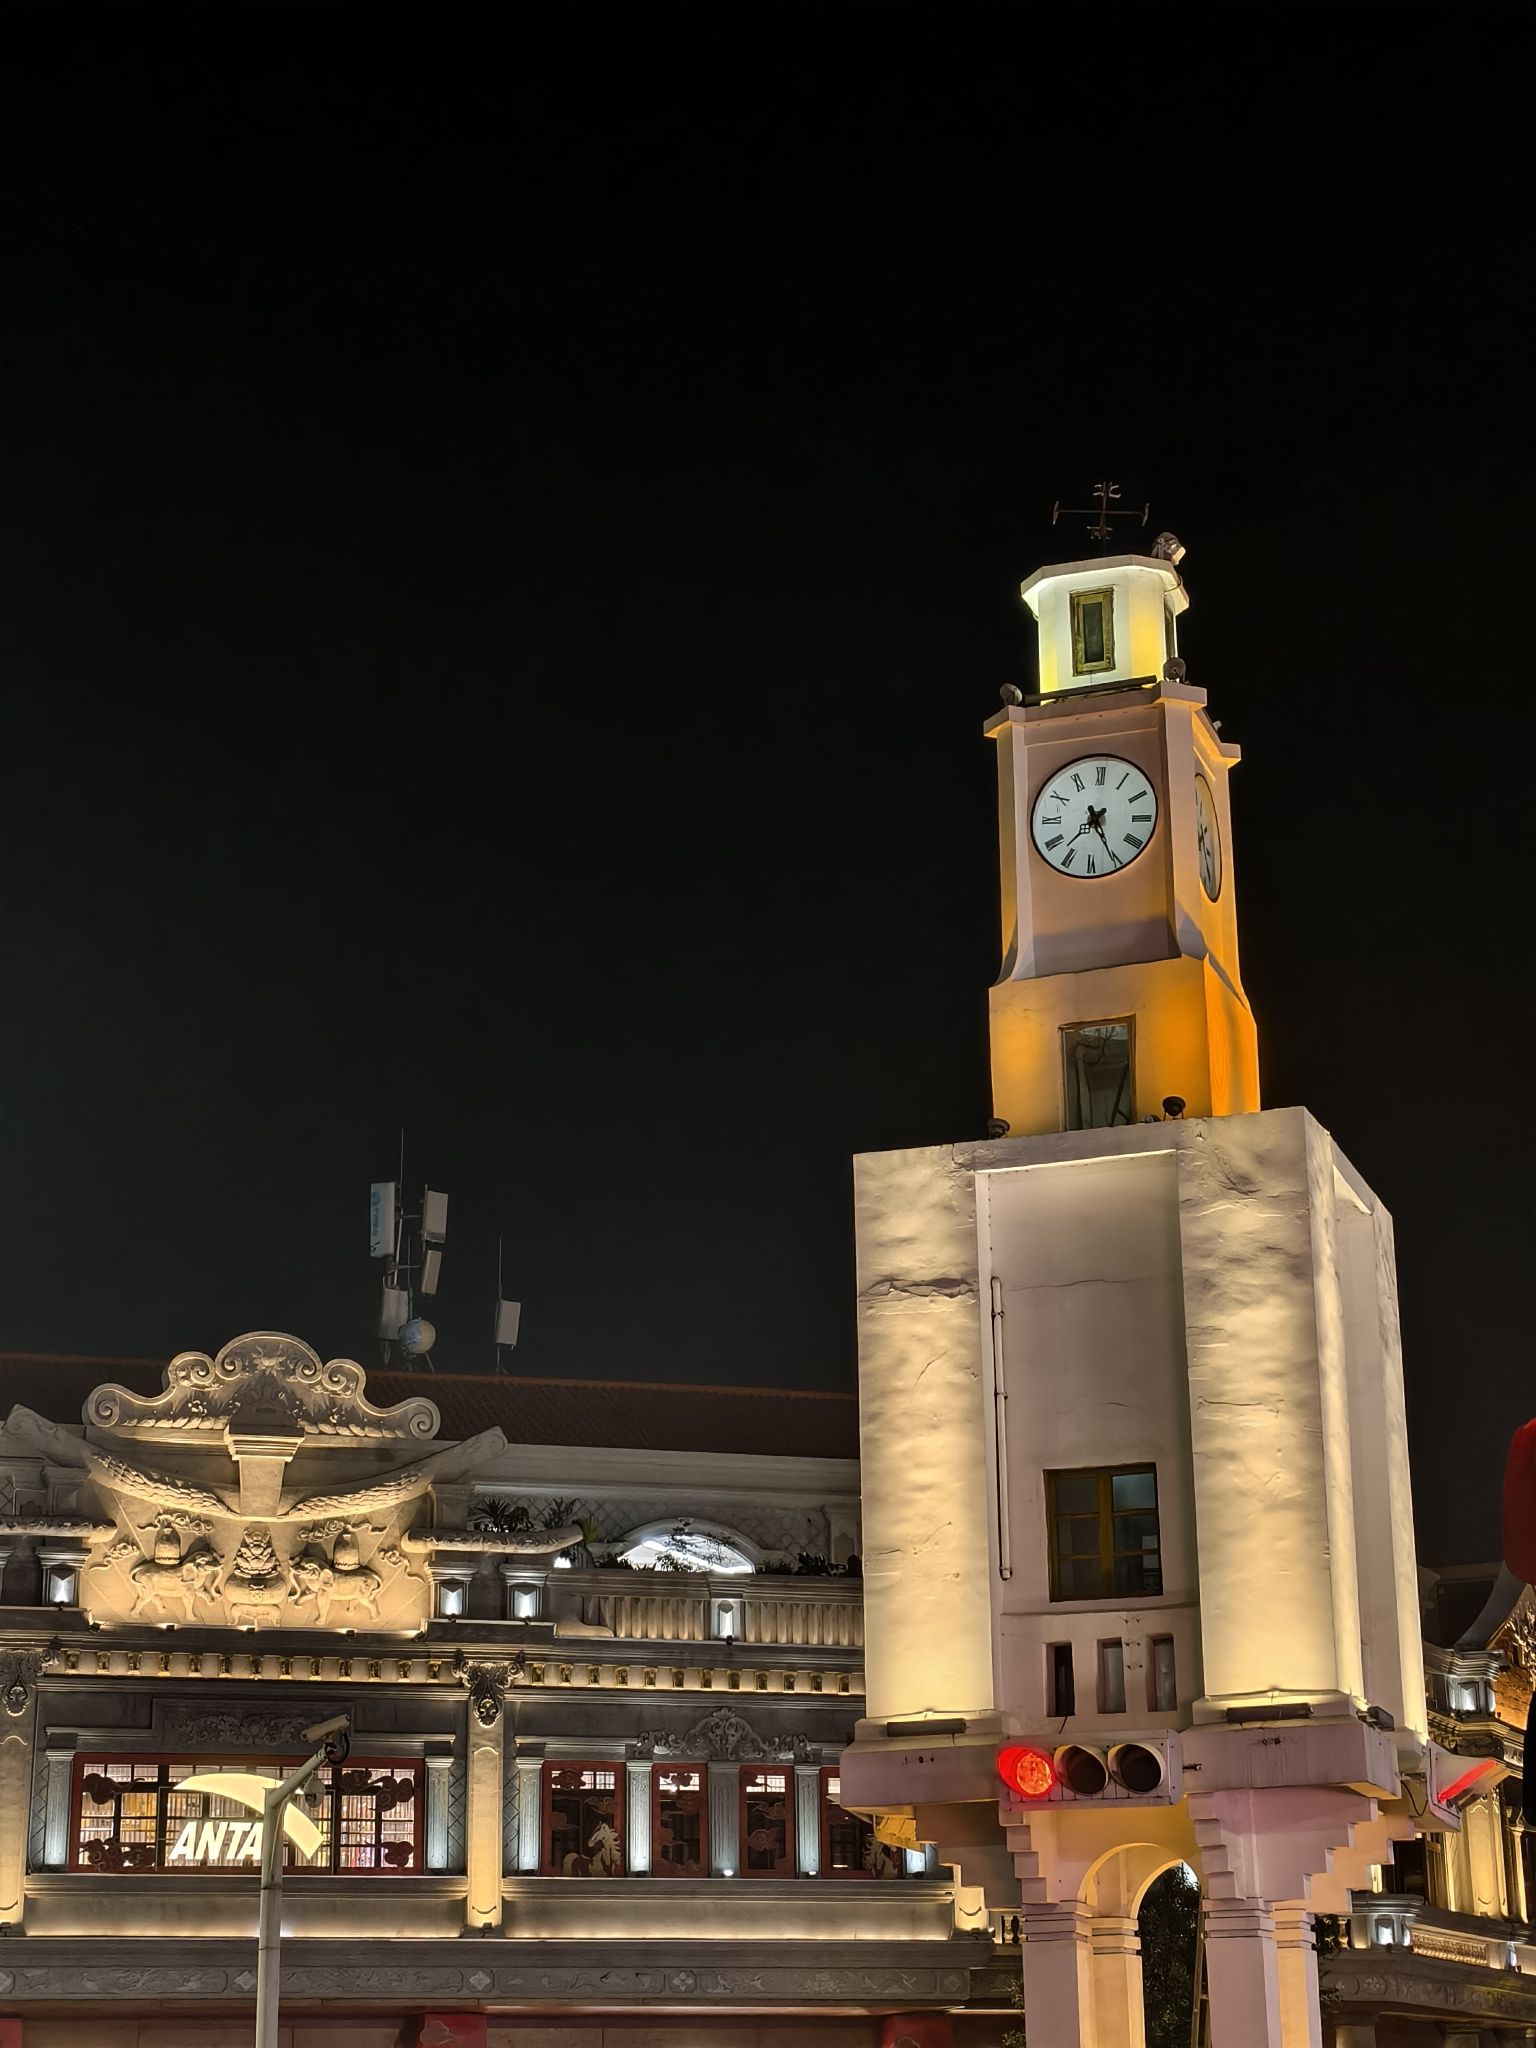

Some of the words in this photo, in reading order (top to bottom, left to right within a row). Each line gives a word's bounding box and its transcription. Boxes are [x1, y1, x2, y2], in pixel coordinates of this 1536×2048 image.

[1070, 773, 1085, 792] XI
[1095, 766, 1106, 786] XII
[1115, 772, 1130, 790] I
[1050, 790, 1071, 807] X
[1128, 789, 1147, 804] II
[1042, 815, 1062, 825] IX
[1131, 814, 1152, 823] III
[1044, 833, 1065, 852] VIII
[1060, 848, 1078, 869] VII
[1086, 854, 1096, 874] VI
[1110, 849, 1124, 868] V
[168, 1821, 264, 1861] ANTA
